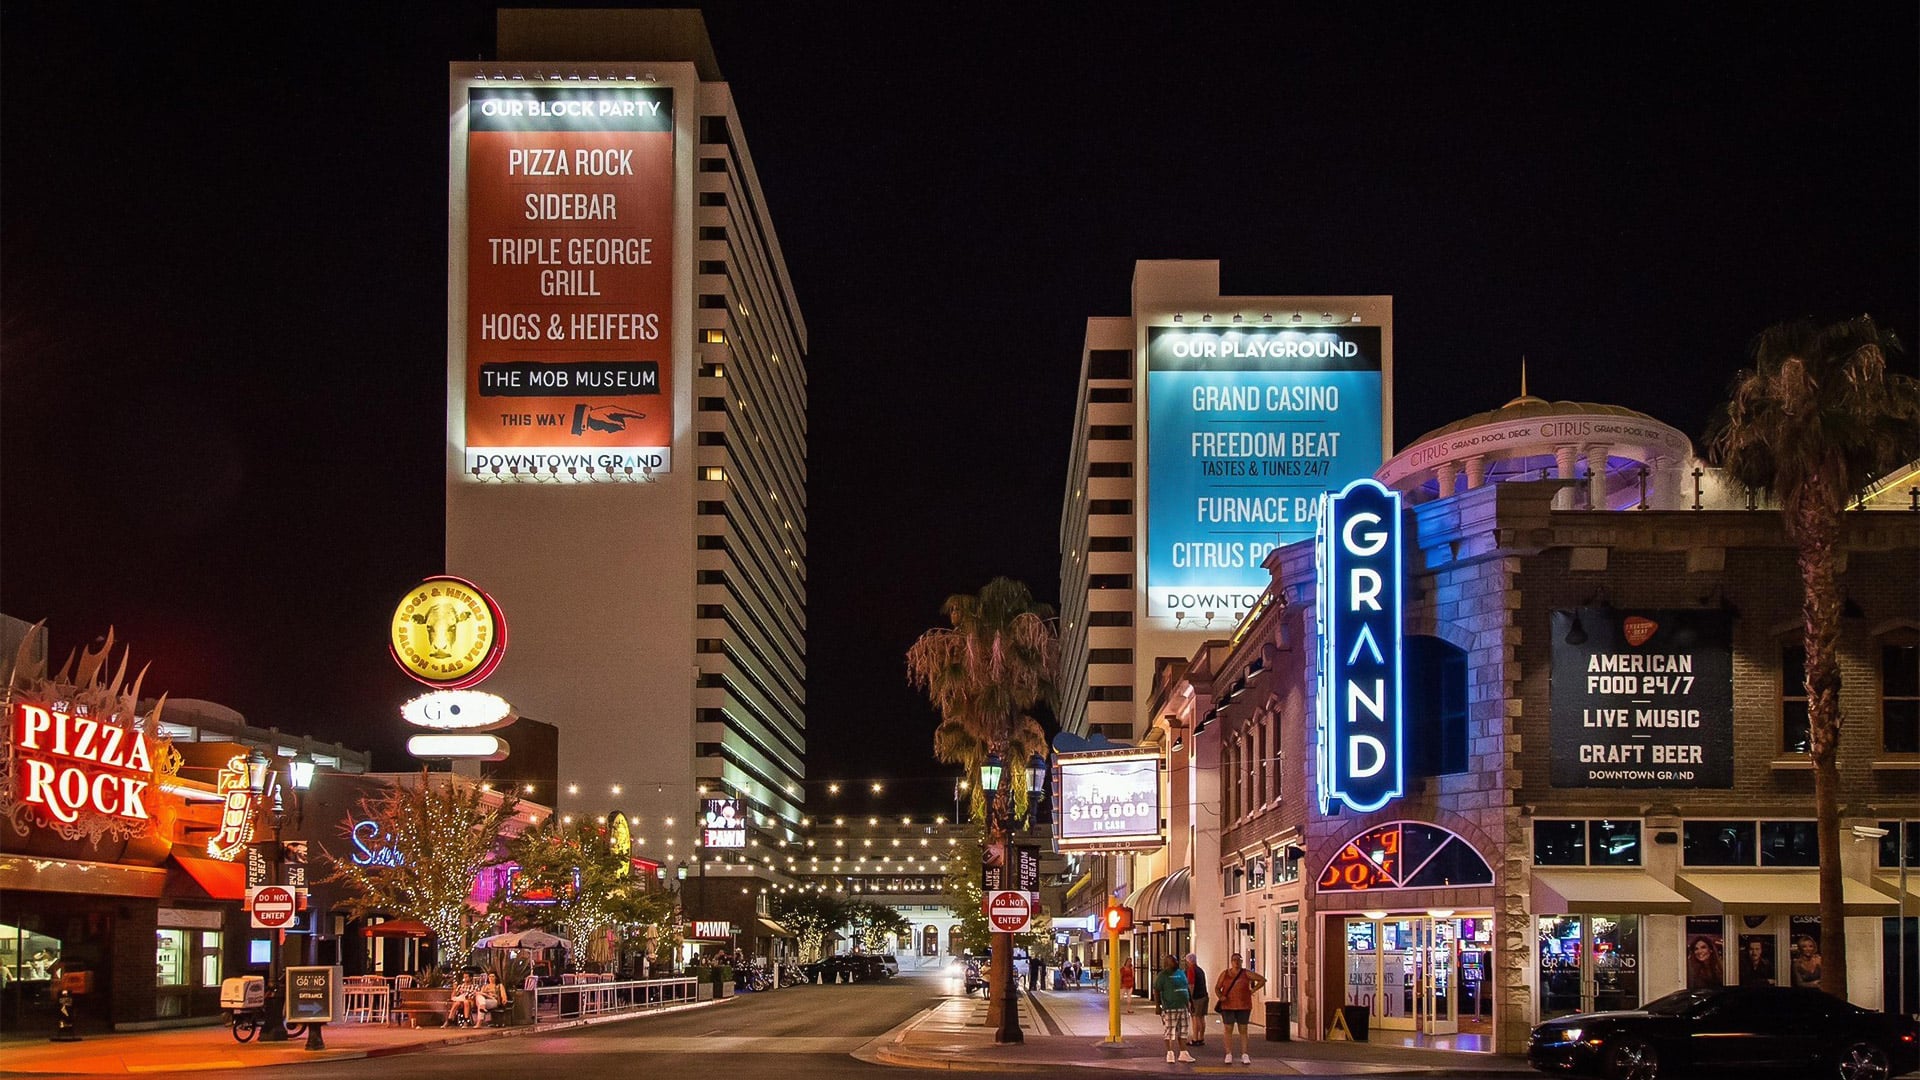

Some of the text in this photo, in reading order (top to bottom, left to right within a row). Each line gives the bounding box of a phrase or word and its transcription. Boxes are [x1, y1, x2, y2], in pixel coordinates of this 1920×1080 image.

[481, 101, 661, 117] OUR BLOCK PARTY
[509, 149, 634, 176] PIZZA ROCK
[525, 193, 617, 220] SIDEBAR
[488, 238, 653, 265] TRIPLE GEORGE
[540, 269, 601, 297] GRILL
[481, 313, 659, 341] HOGS & HEIFERS
[1172, 341, 1359, 358] OUR PLAYGROUND
[483, 371, 656, 387] THE MOB MUSEUM
[1192, 386, 1339, 411] GRAND CASINO
[501, 413, 566, 427] THIS WAY
[1541, 421, 1592, 438] CITRUS
[1594, 424, 1622, 434] GRAND
[1623, 426, 1644, 437] POOL
[1191, 432, 1341, 458] FREEDOM BEAT
[1410, 428, 1532, 467] CITRUS GRAND POOL DECK
[476, 454, 663, 469] DOWNTOWN GRAND
[1201, 460, 1330, 477] TASTES & TUNES 24/7
[1197, 497, 1318, 523] FURNACE BA
[1172, 542, 1244, 568] CITRUS
[401, 587, 485, 622] HOGS & HEIFERS
[1168, 594, 1261, 609] DOWNTO
[399, 625, 486, 673] SALOON LAS VEGAS
[1342, 512, 1388, 779] GRAND
[1587, 654, 1692, 672] AMERICAN
[1587, 676, 1695, 694] FOOD 24/7
[1583, 709, 1700, 728] LIVE MUSIC
[21, 704, 153, 773] PIZZA
[1073, 749, 1145, 758] DOWNTOWN
[1579, 744, 1703, 764] CRAFT BEER
[220, 773, 249, 790] Tak
[1589, 770, 1694, 780] DOWNTOWN GRAND
[26, 759, 149, 823] ROCK
[226, 794, 247, 843] OUT
[1069, 802, 1150, 821] $10,000
[1093, 820, 1126, 830] IN CASH
[709, 830, 746, 847] PAWN
[257, 853, 266, 875] BEAT
[1020, 851, 1029, 891] FREEDOM
[1028, 857, 1037, 877] BEAT
[288, 867, 297, 886] 24/7
[296, 868, 304, 886] FOOD
[854, 878, 885, 892] THE
[892, 878, 925, 892] MOB
[985, 870, 993, 886] LIVE
[259, 894, 288, 902] DO NOT
[696, 921, 730, 937] PAWN
[1541, 957, 1580, 968] GRND
[296, 978, 326, 986] GRND
